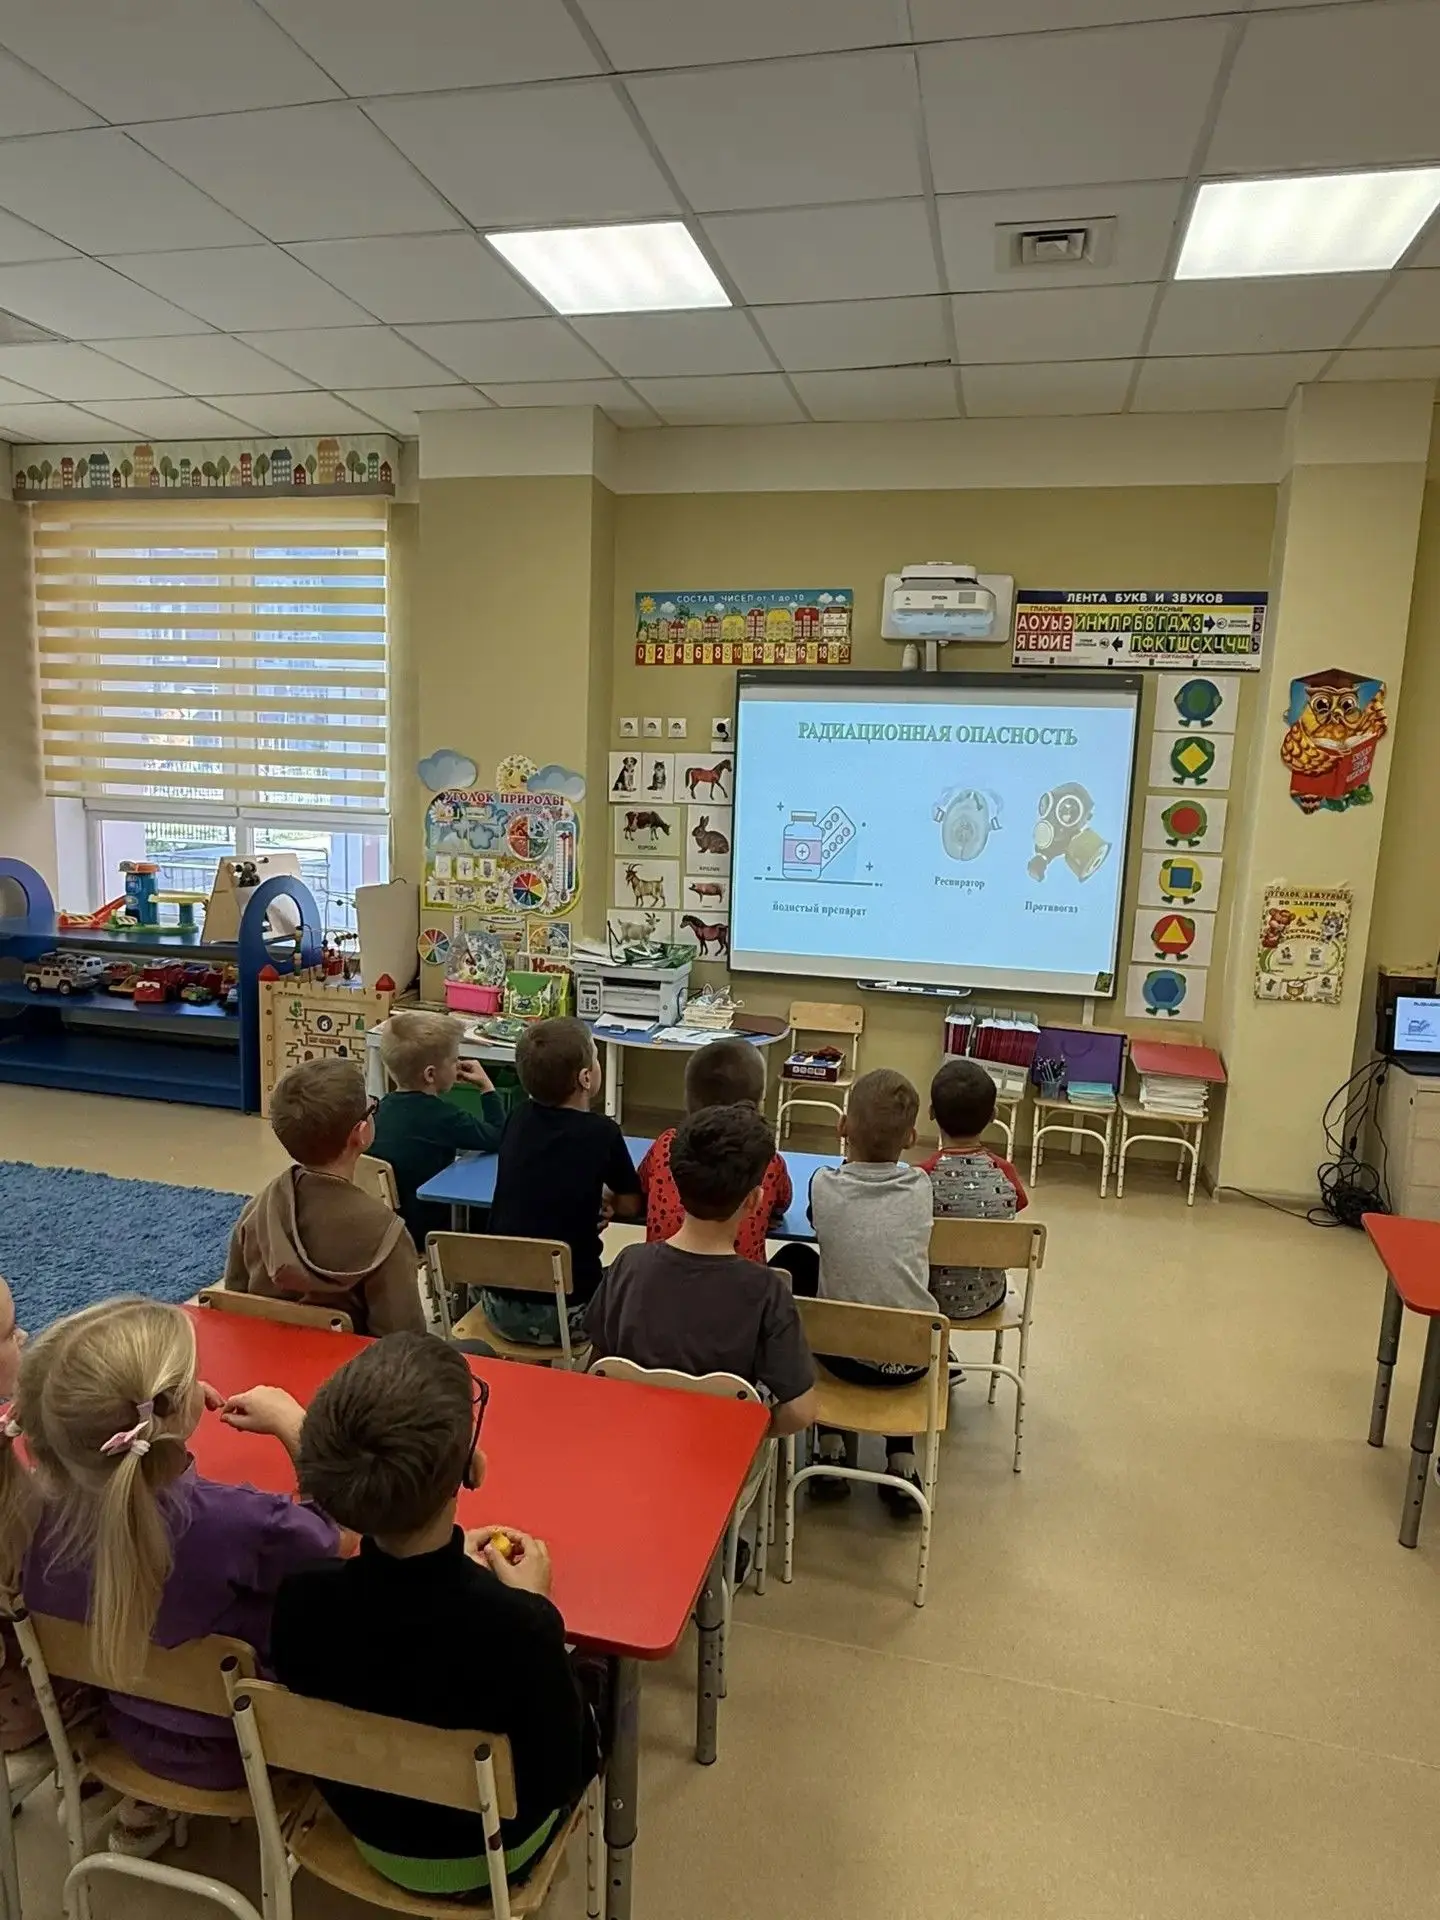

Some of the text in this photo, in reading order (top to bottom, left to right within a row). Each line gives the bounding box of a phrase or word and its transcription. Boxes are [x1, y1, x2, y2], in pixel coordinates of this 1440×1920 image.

[676, 595, 715, 603] СОСТАВ
[720, 594, 754, 603] ЧИСЕЛ
[1066, 592, 1224, 603] ЛЕНТА БУКВ И ЗВУКОВ
[656, 647, 663, 659] 2
[676, 647, 682, 659] 4
[695, 647, 701, 659] 6
[715, 647, 721, 659] 8
[733, 647, 742, 659] 10
[754, 646, 763, 659] 12
[775, 646, 784, 659] 14
[797, 646, 806, 659] 16
[819, 646, 827, 659] 18
[839, 646, 849, 658] 20
[798, 721, 1078, 746] РАДИАЦИОННАЯ ОПАСНОСТЬ
[445, 791, 564, 806] УГОЛОК ПРИРОДЫ
[934, 876, 985, 890] Респиратор
[821, 905, 867, 918] препарат
[1024, 900, 1078, 913] Противогаз
